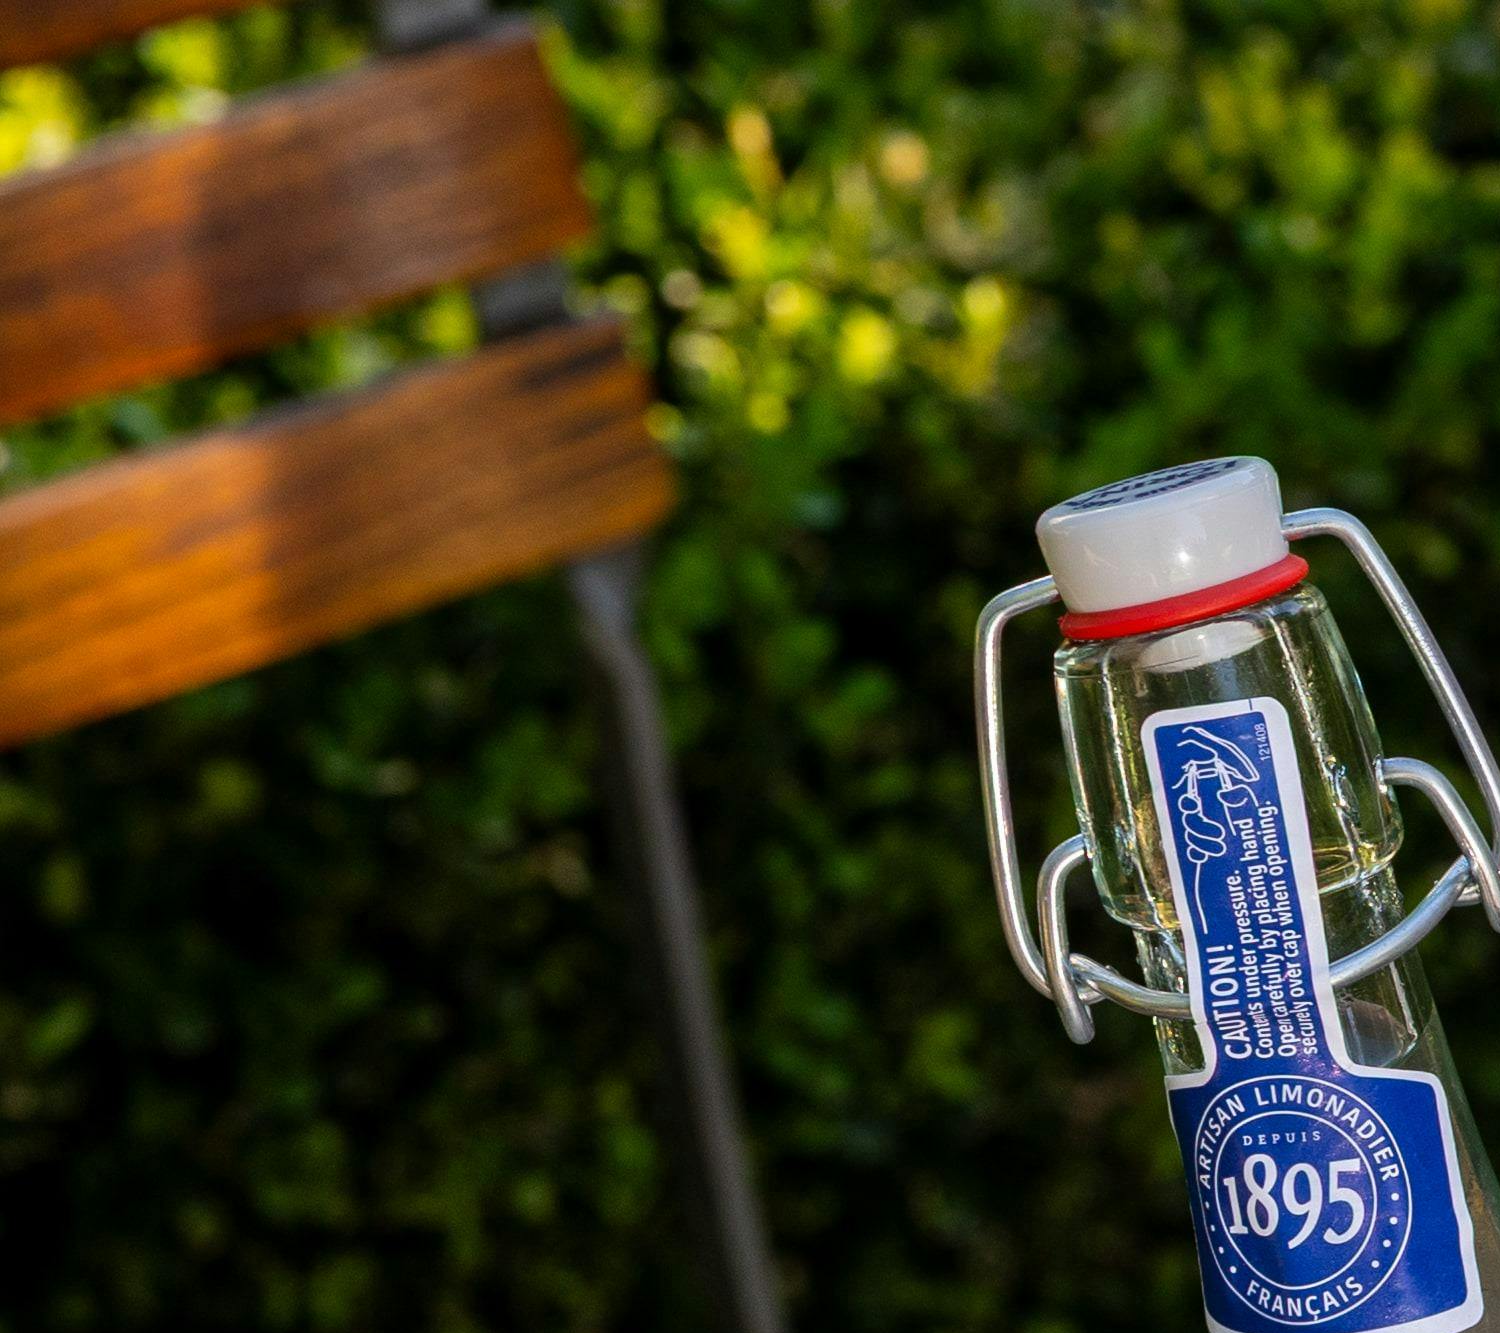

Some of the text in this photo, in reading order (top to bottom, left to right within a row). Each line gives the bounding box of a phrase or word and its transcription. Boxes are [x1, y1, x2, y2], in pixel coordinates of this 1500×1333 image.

[1254, 723, 1271, 761] 121408
[1227, 870, 1275, 1059] Contents under pressure.
[1233, 818, 1301, 1057] Open carefully by placing hand
[1257, 800, 1318, 1056] securely over cap when opening.
[1206, 943, 1253, 1060] CAUTION!
[1199, 1083, 1400, 1190] ARTISAN LIMONADIER
[1242, 1130, 1322, 1147] DEPUIS
[1223, 1153, 1366, 1250] 1895
[1246, 1276, 1364, 1321] FRANÇAIS
